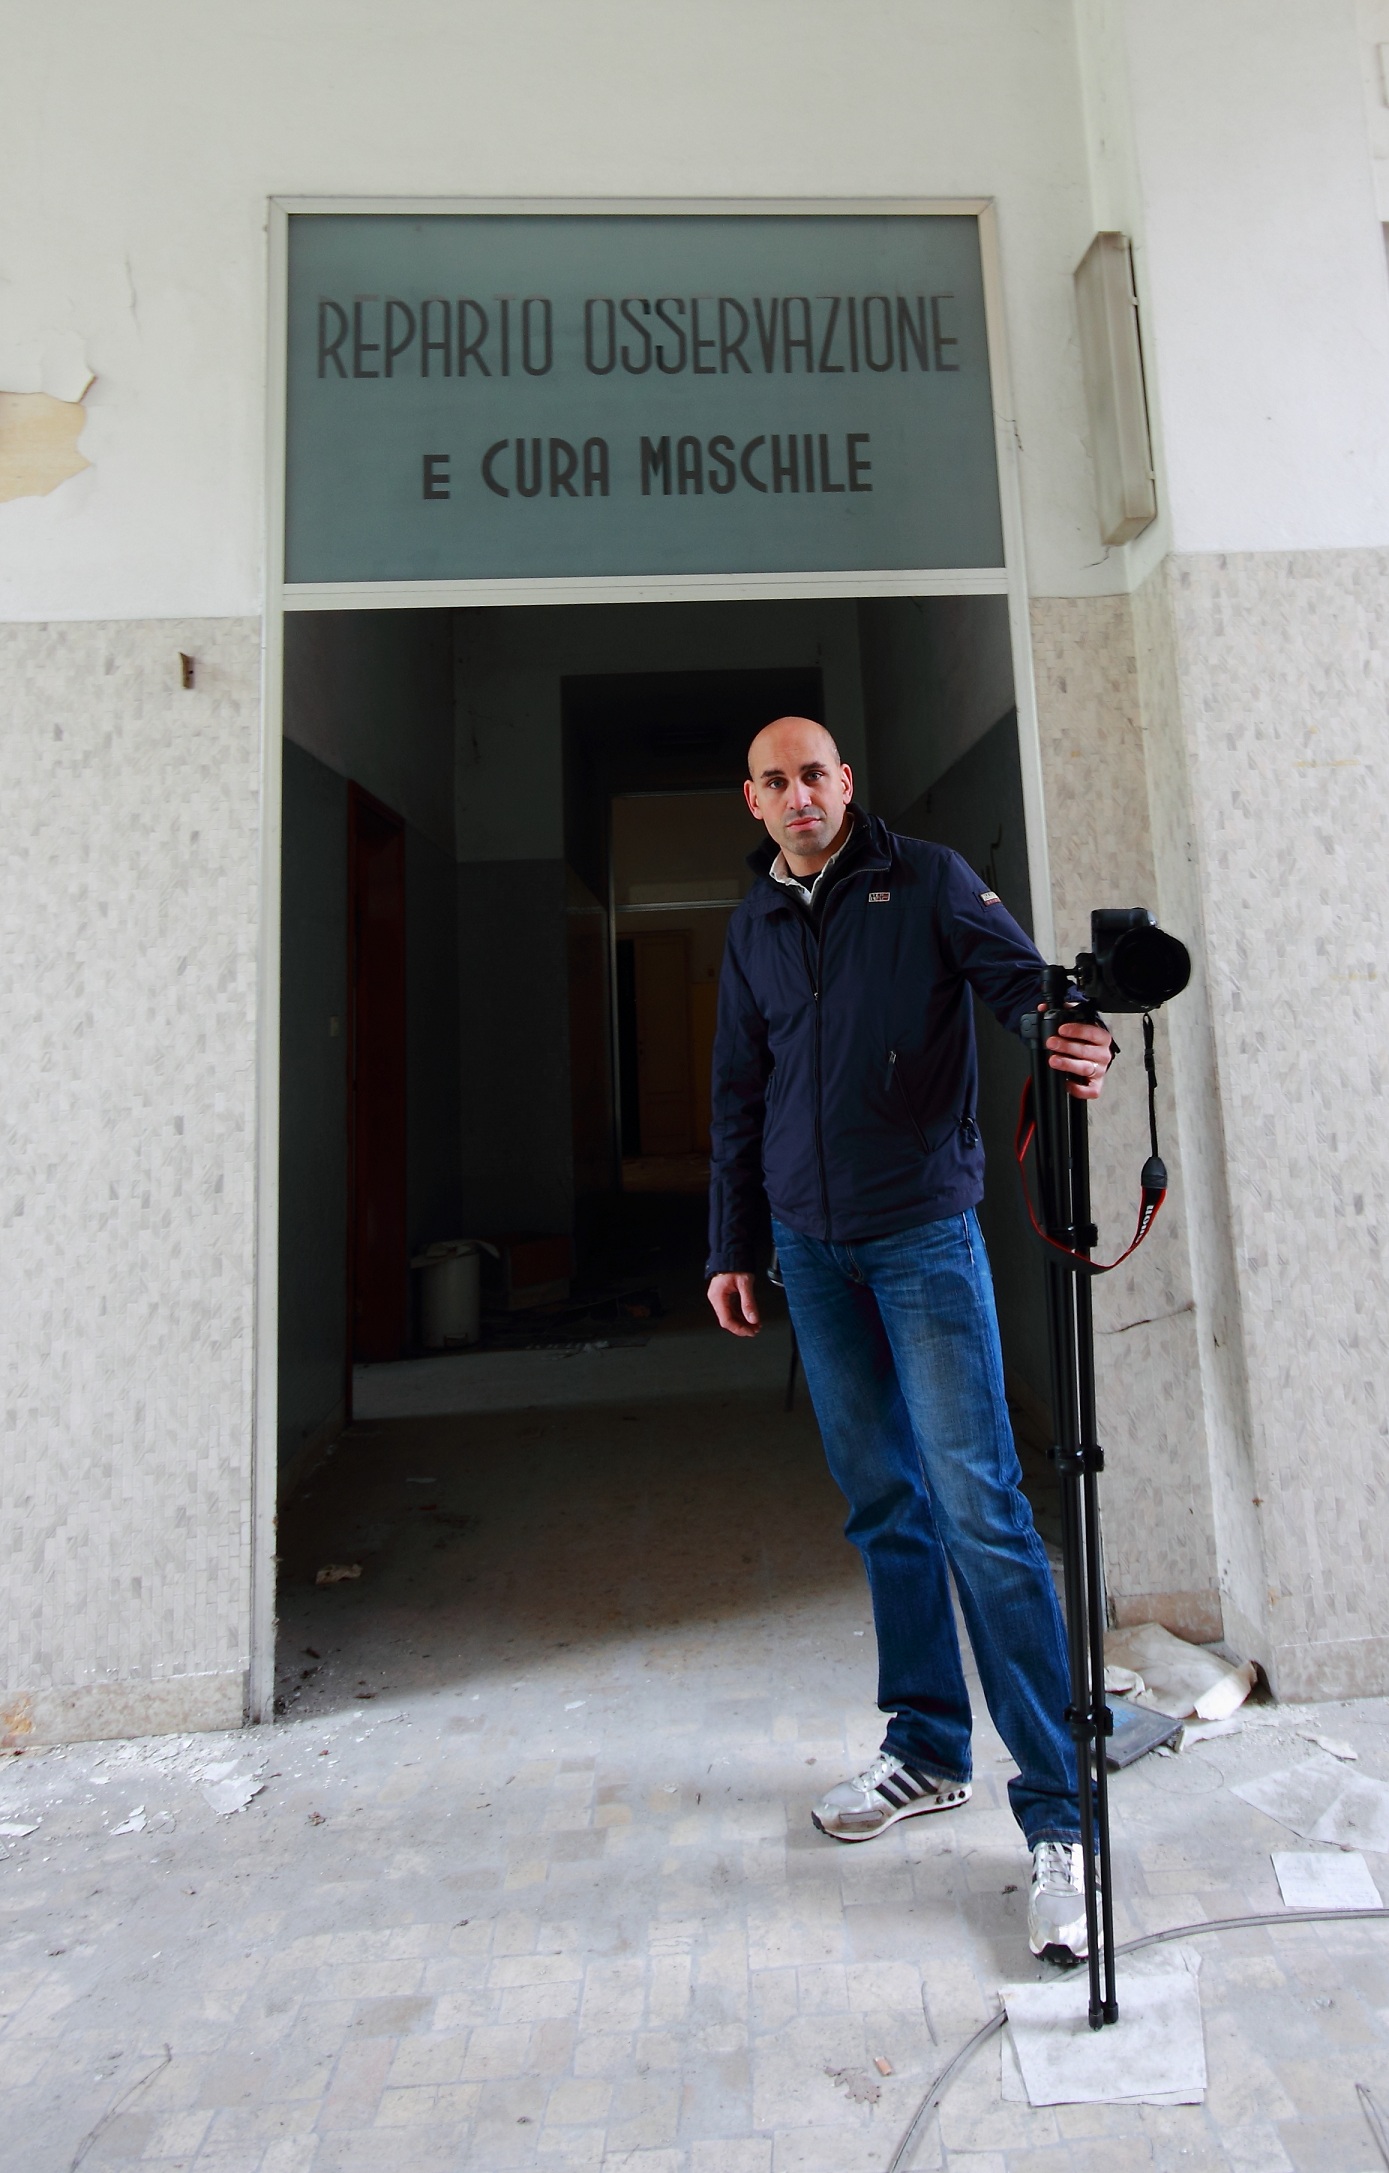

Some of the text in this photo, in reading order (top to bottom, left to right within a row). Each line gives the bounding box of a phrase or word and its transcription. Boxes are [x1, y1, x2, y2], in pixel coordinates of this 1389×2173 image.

[317, 294, 960, 379] REPARTO OSSERVAZIONE
[423, 432, 873, 500] E CURA MASCHILE
